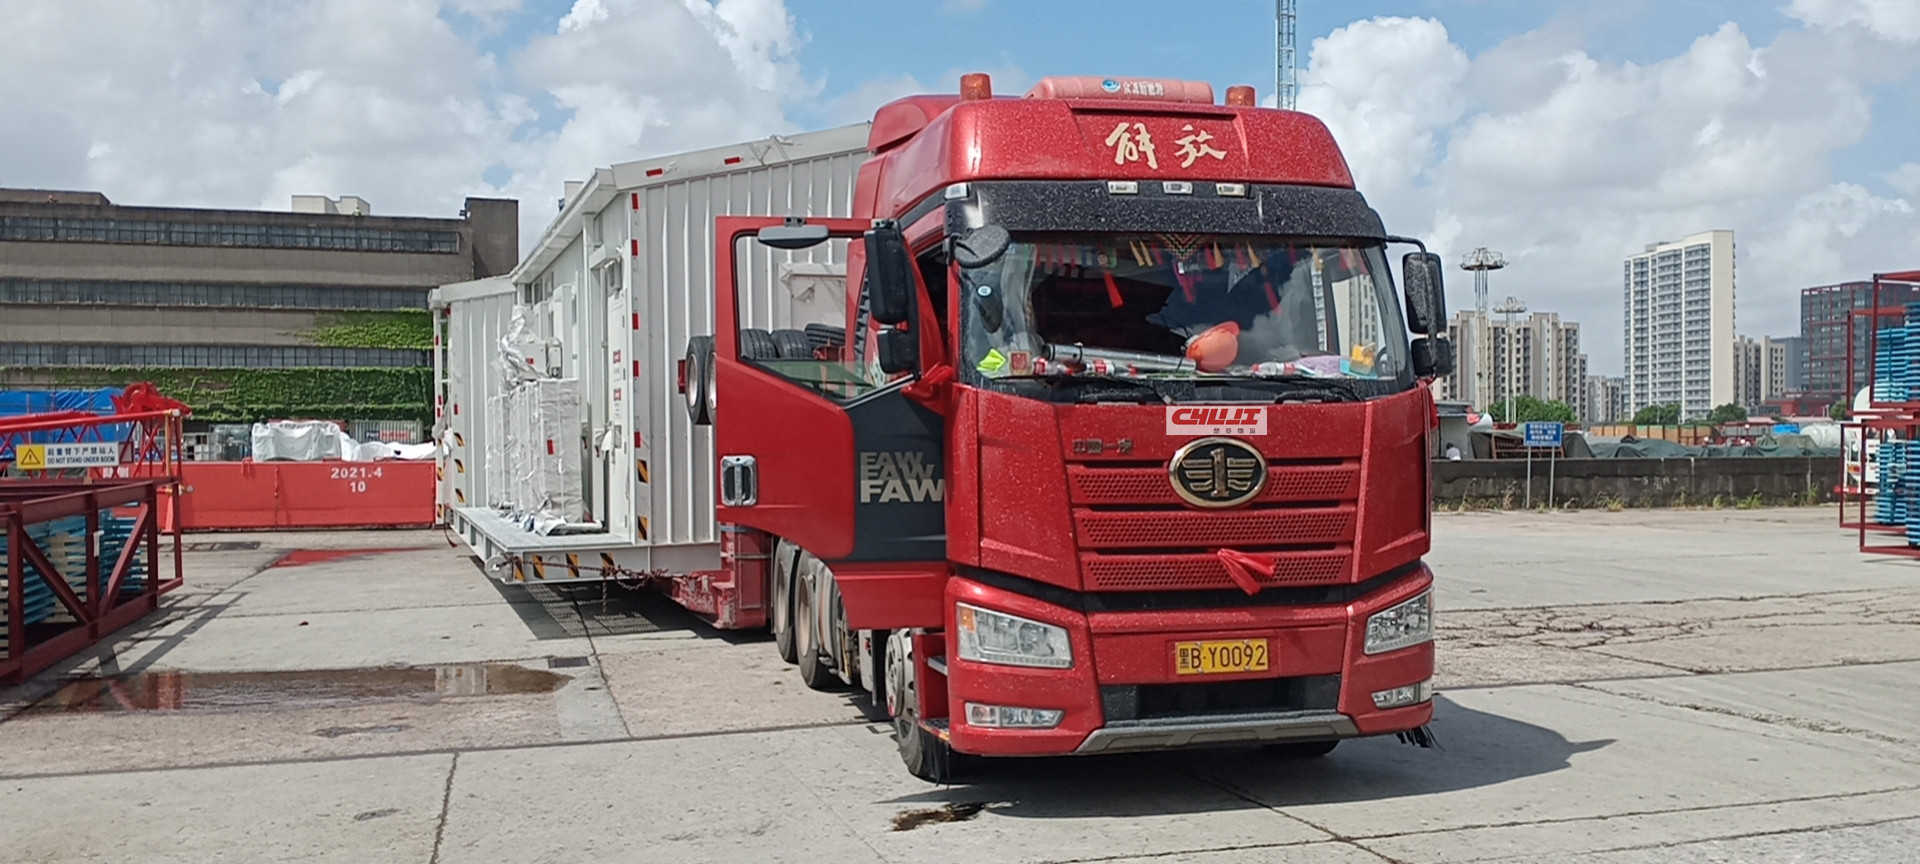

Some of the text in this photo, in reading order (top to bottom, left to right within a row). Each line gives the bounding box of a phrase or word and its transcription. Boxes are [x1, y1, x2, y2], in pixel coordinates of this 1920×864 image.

[1105, 122, 1227, 169] 解放
[47, 457, 55, 465] DO
[67, 456, 82, 464] STAND
[331, 467, 382, 479] 2021.4
[350, 481, 366, 493] 10
[861, 479, 945, 503] FAW
